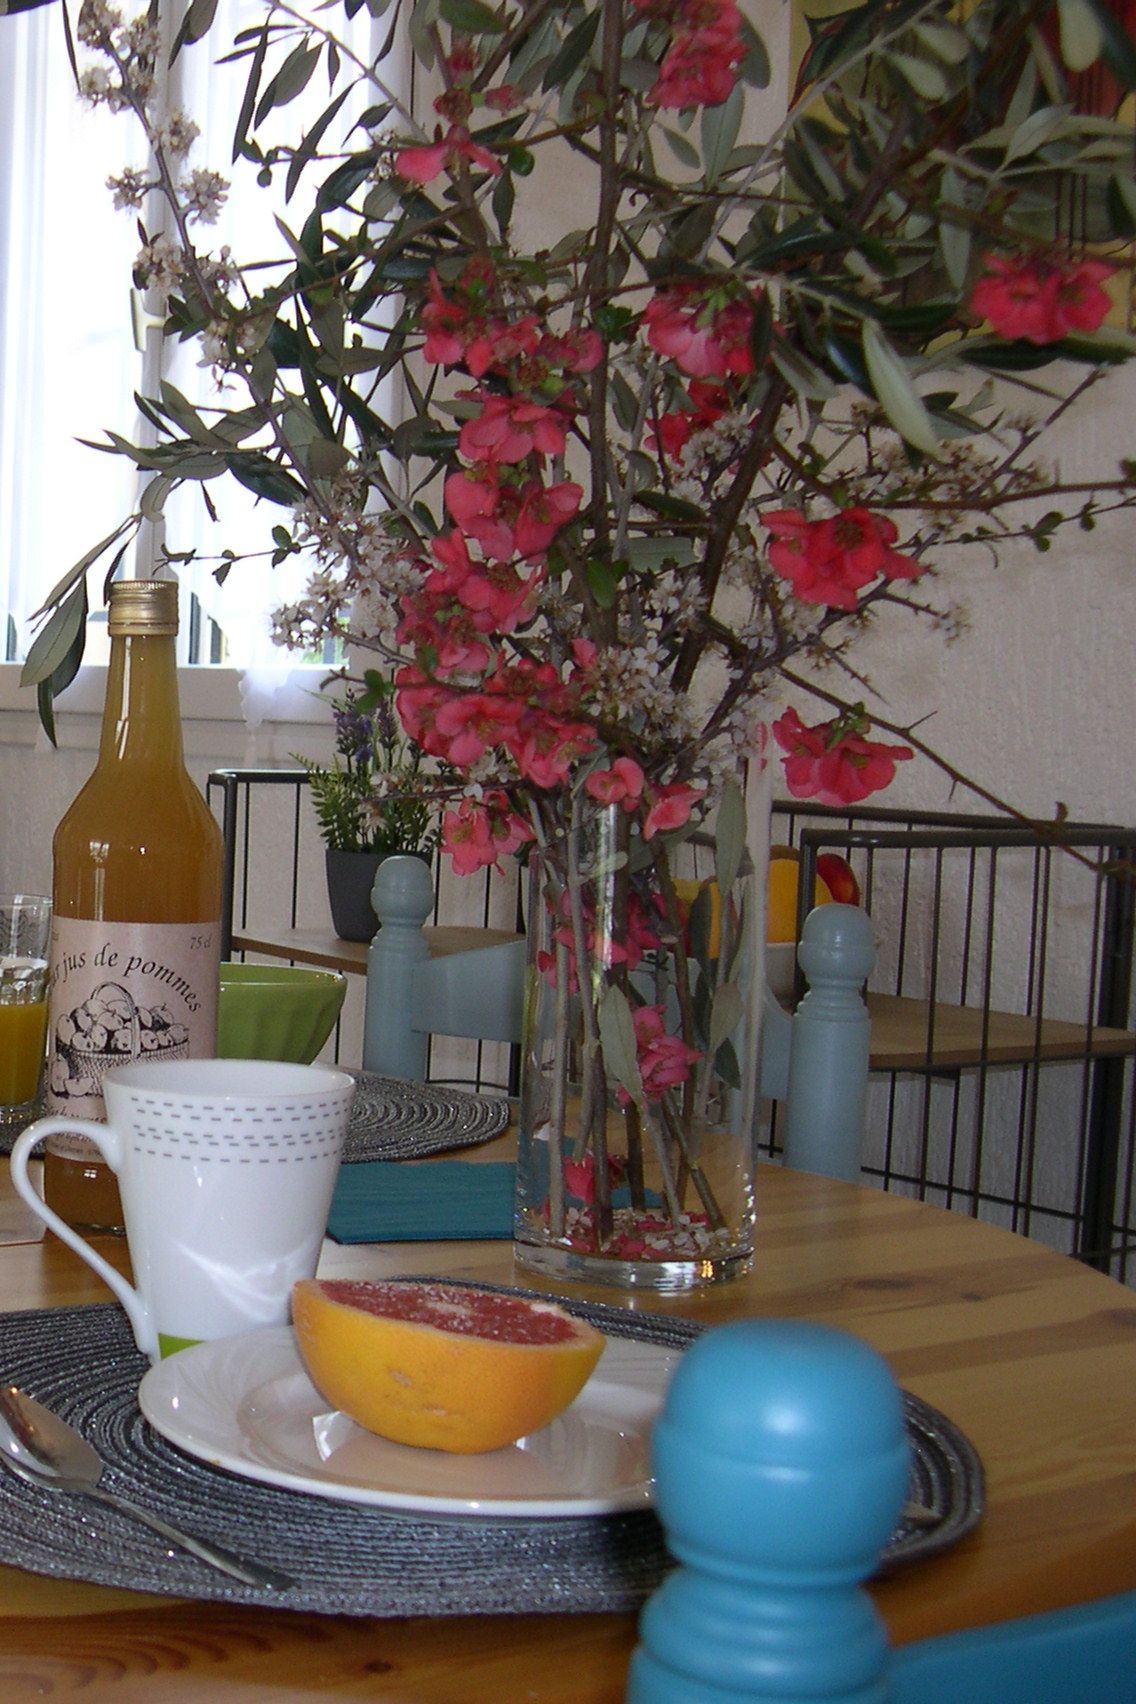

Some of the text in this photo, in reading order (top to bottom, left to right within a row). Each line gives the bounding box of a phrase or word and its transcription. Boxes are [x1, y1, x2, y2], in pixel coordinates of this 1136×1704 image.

[63, 952, 86, 982] jus
[94, 943, 119, 967] de
[123, 956, 202, 1013] pommes
